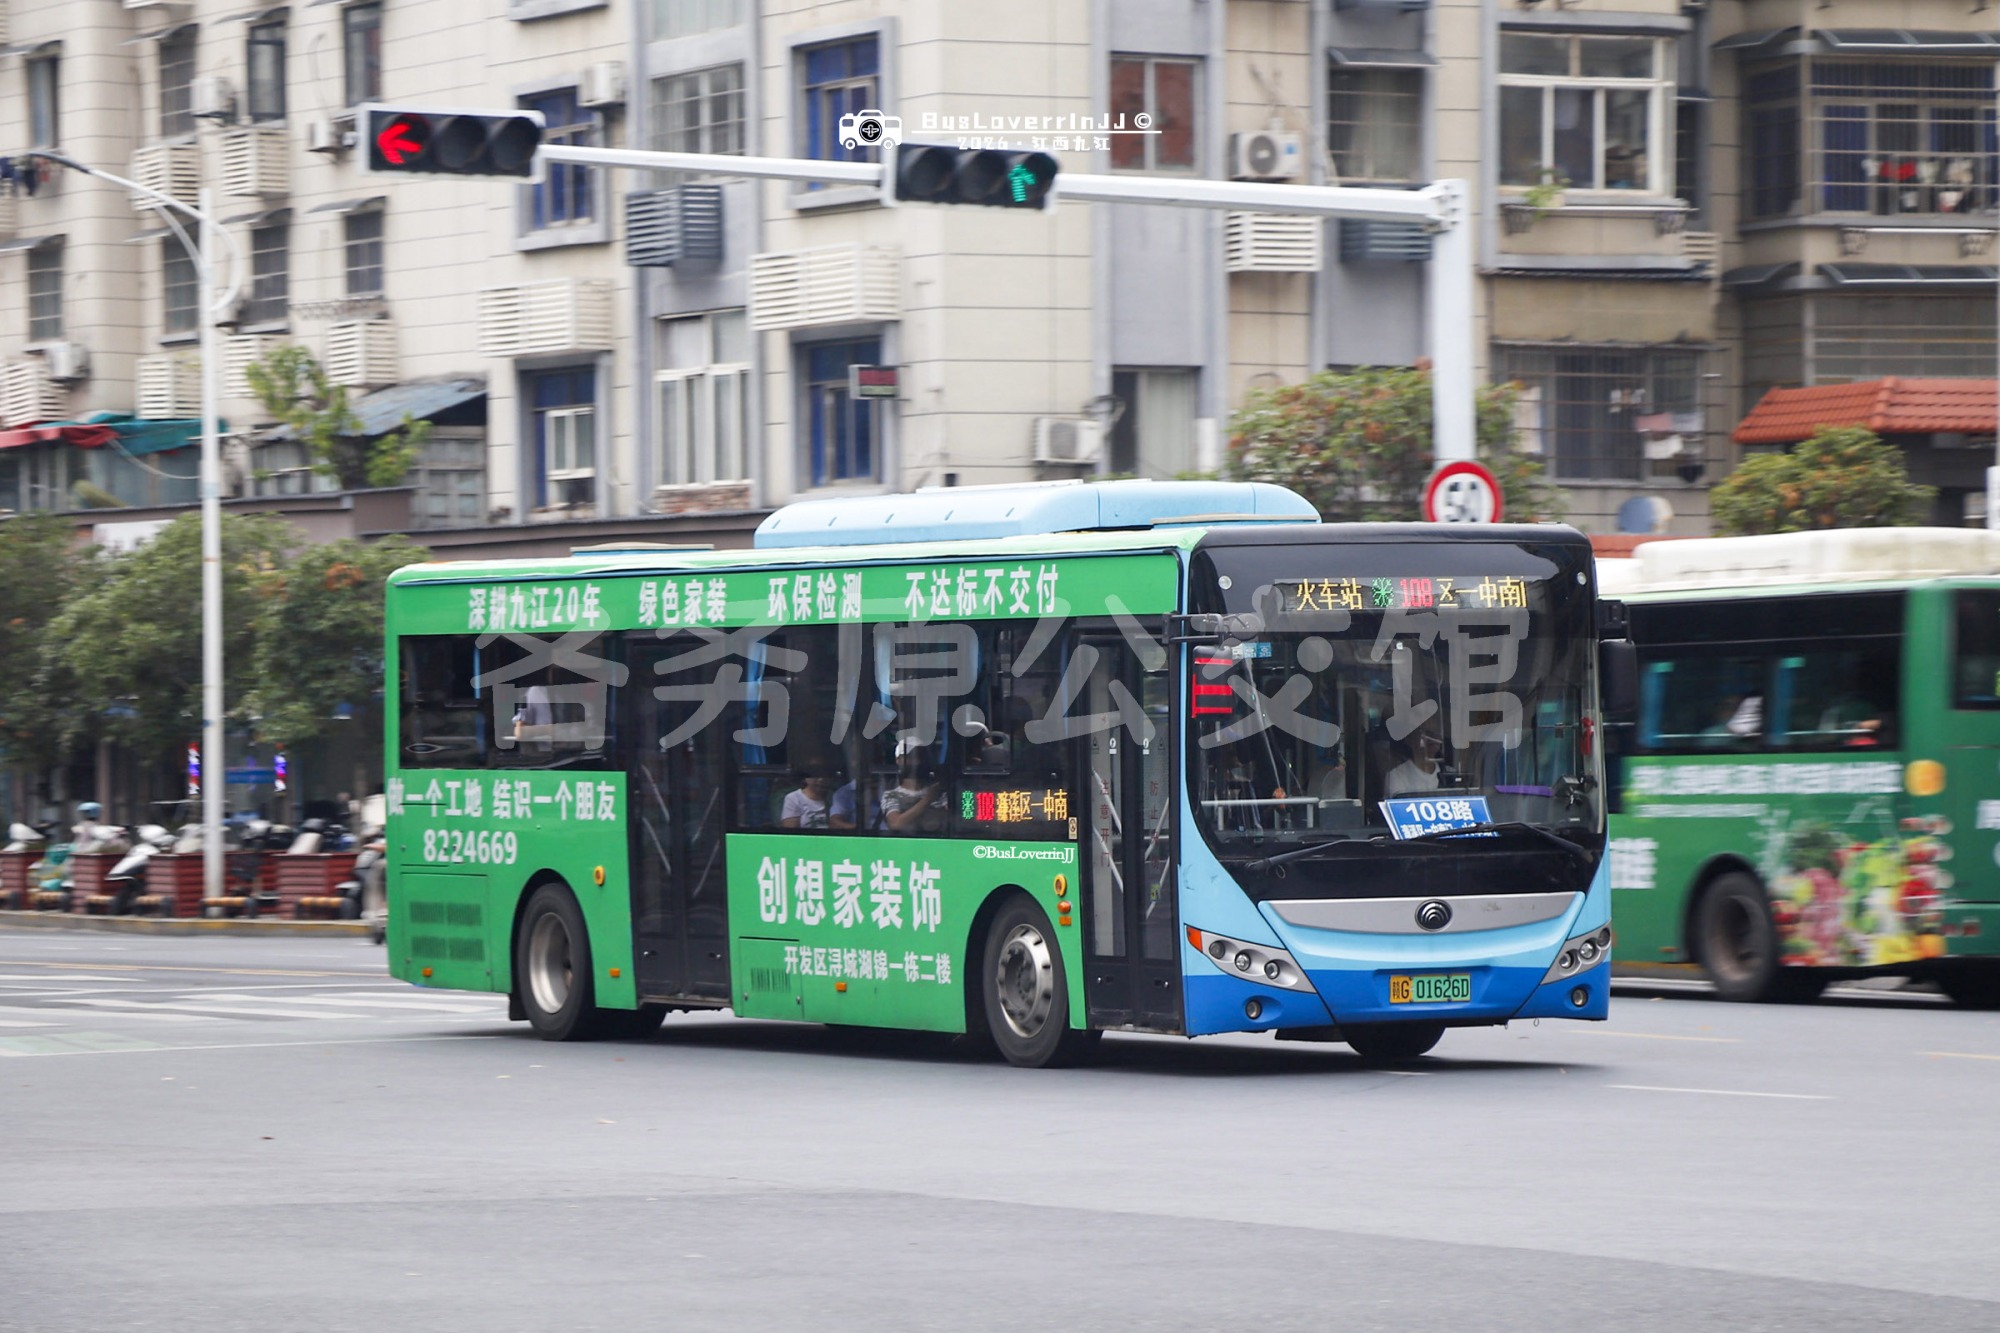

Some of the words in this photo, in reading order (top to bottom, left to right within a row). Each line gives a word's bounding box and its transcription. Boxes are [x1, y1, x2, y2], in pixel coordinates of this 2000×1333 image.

[468, 583, 601, 630] 深耕九江20年
[638, 578, 727, 625] 绿色家装
[768, 571, 862, 622] 环保检测
[904, 564, 1059, 619] 不达标不交付
[1297, 577, 1363, 611] 火车站
[1399, 578, 1434, 608] 108
[1436, 576, 1528, 608] 区一中南
[387, 778, 482, 816] 做一个工地
[492, 779, 616, 821] 结识一个朋友
[1406, 799, 1475, 822] 108路
[423, 829, 517, 865] 8224669
[757, 856, 942, 933] 创想家装饰
[784, 946, 952, 984] 开发区浔城湖锦一栋二楼
[1416, 978, 1469, 999] 01626D
